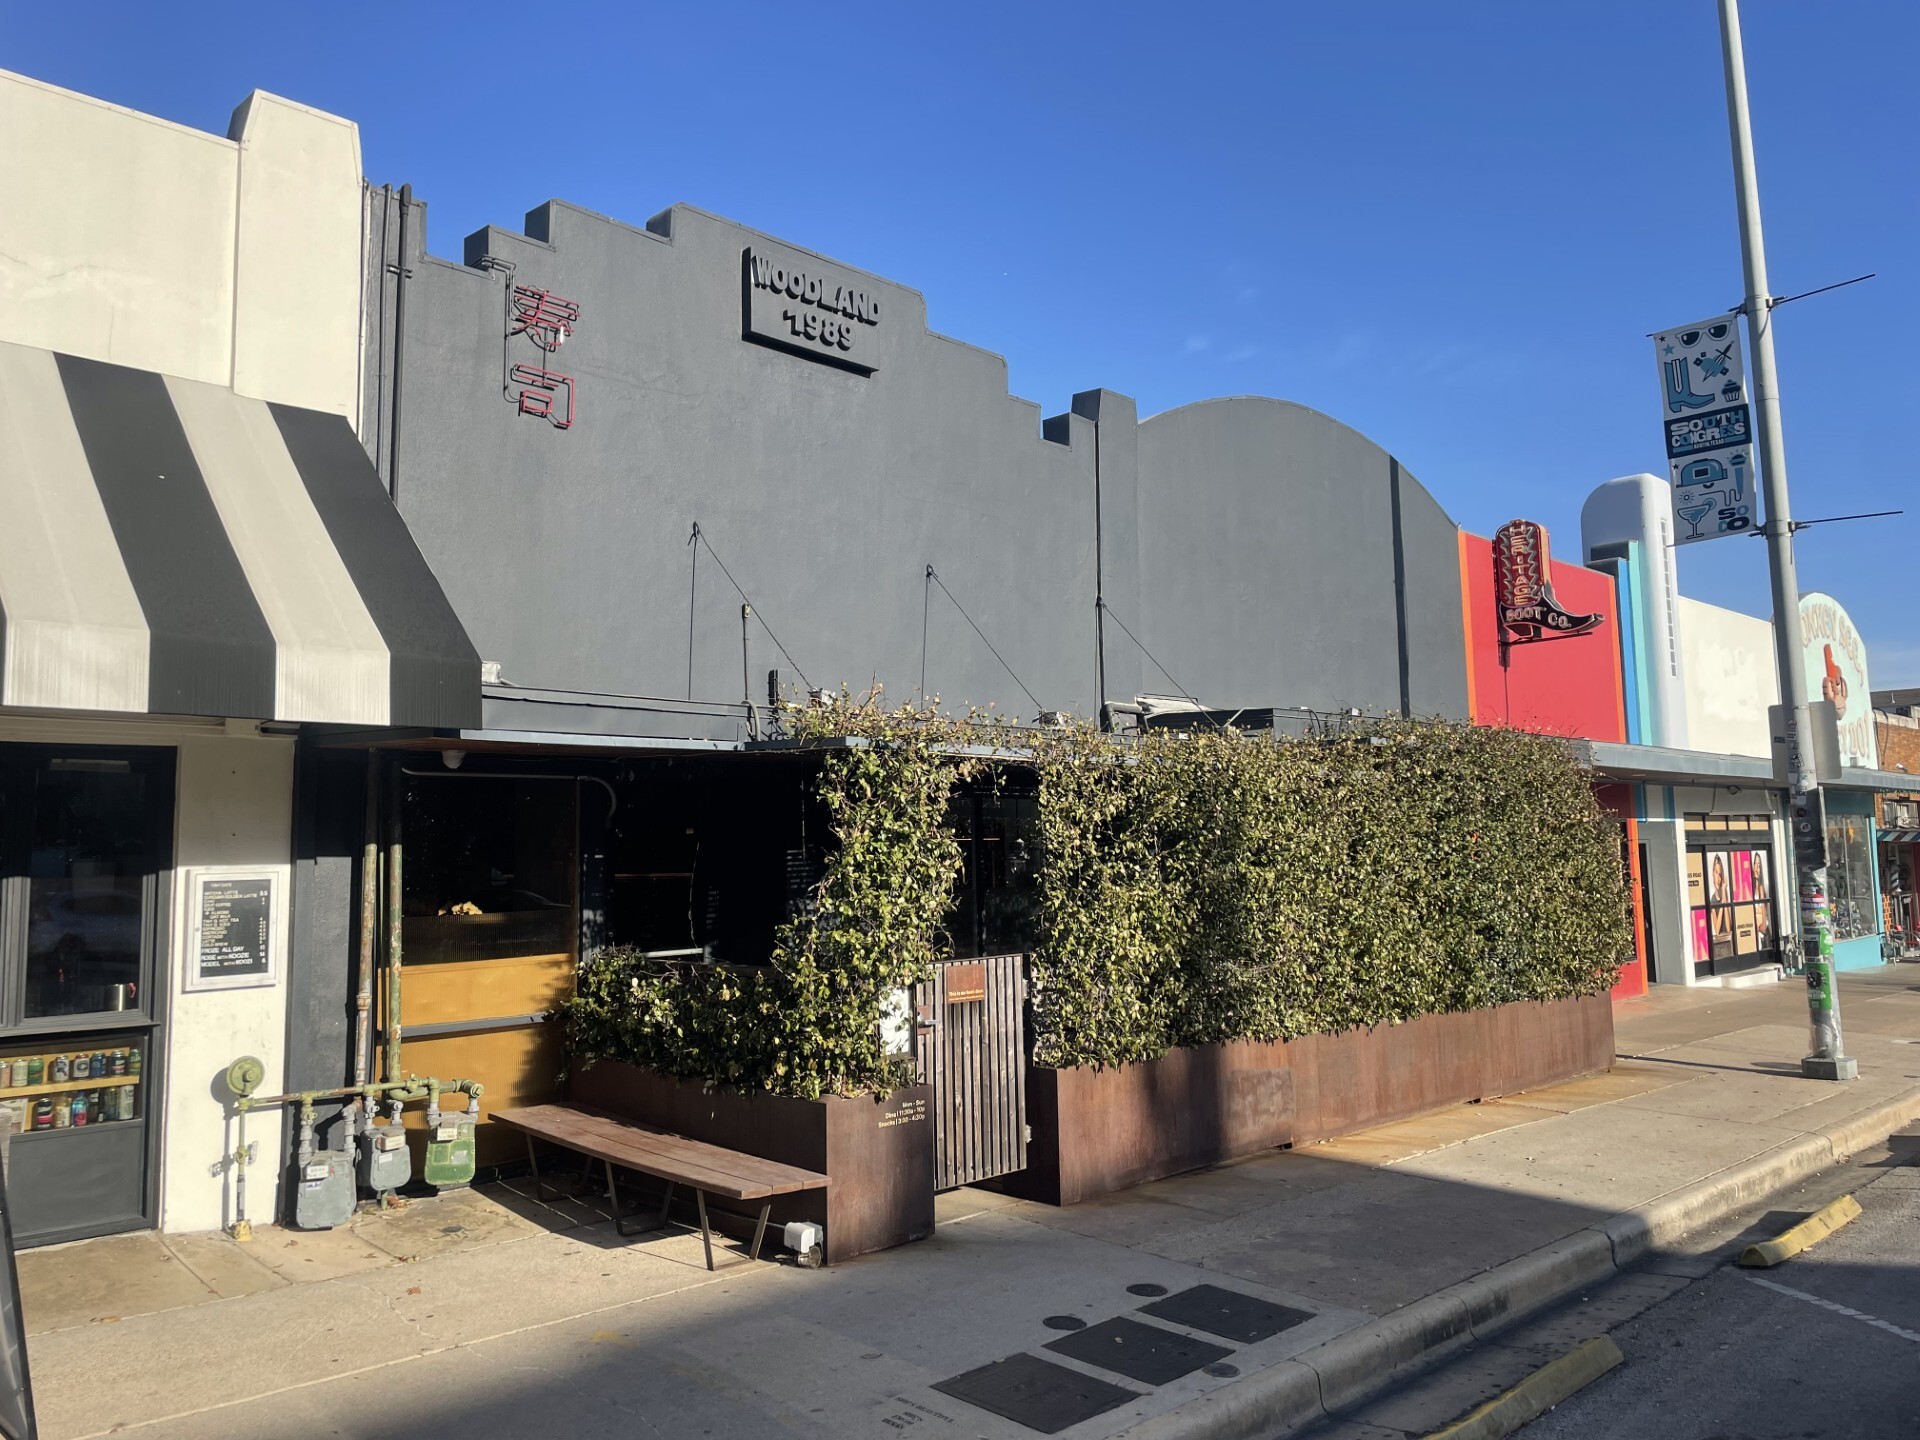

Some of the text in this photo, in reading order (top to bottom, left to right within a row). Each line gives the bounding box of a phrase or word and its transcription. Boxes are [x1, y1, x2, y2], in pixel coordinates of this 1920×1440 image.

[751, 255, 881, 326] WOODLAND
[782, 309, 856, 351] 1989
[1670, 410, 1745, 436] SOUTH
[1671, 422, 1746, 448] CONGRESS
[1717, 505, 1749, 520] SO
[1509, 524, 1532, 606] HERITAGE
[1505, 606, 1546, 622] BOOT
[1800, 603, 1837, 648] ONKEY
